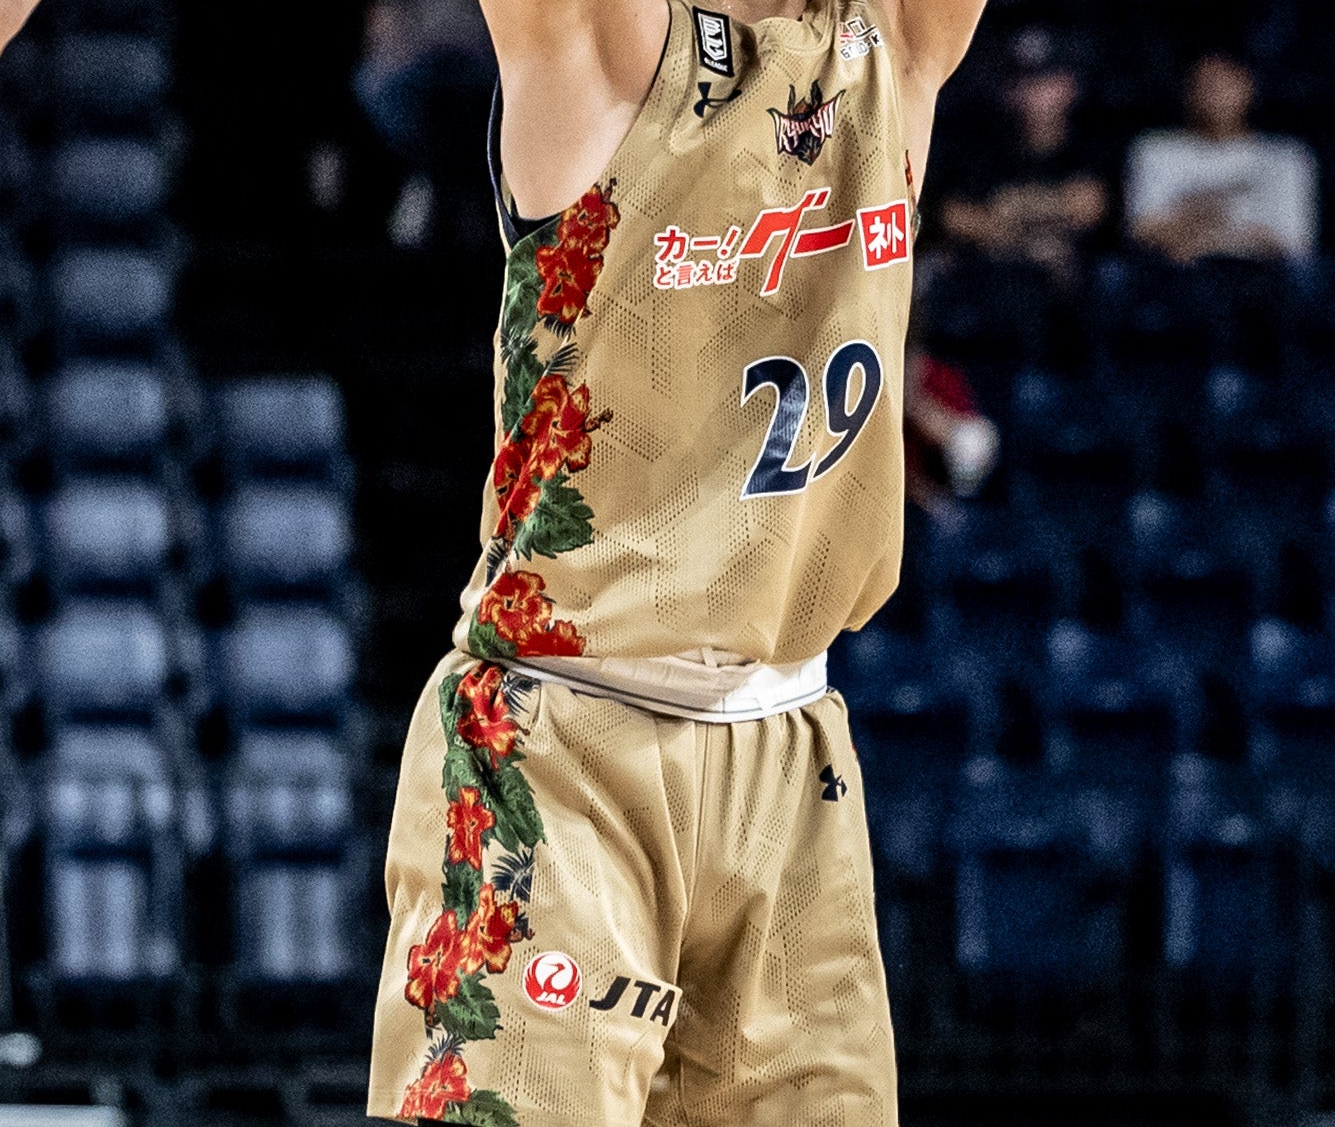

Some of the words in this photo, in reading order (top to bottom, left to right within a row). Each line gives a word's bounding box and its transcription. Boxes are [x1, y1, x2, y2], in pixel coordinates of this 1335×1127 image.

[653, 260, 738, 289] と言えば
[739, 339, 884, 501] 29
[536, 991, 566, 1005] JAL
[588, 975, 677, 1027] JTA
